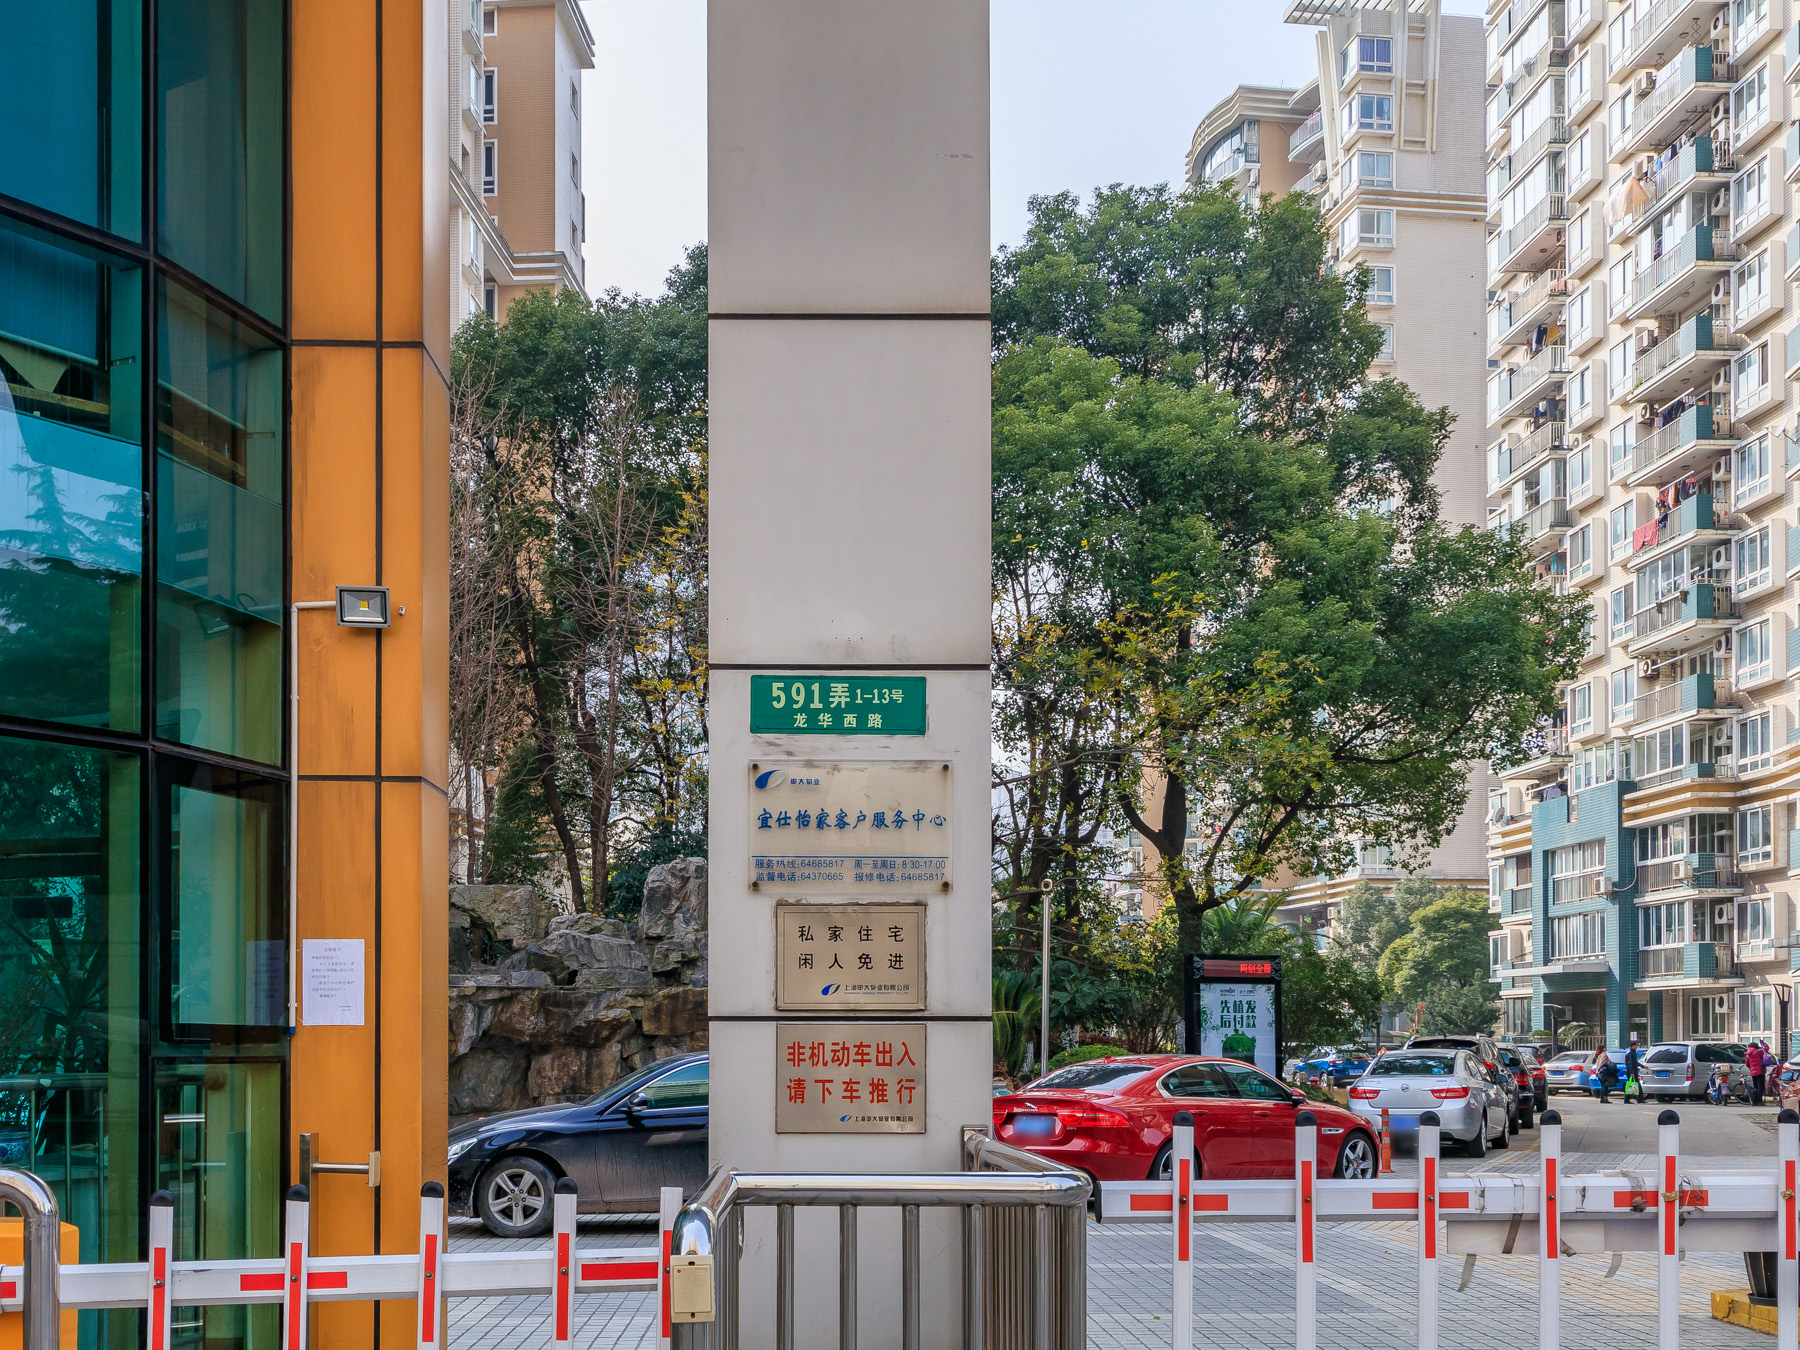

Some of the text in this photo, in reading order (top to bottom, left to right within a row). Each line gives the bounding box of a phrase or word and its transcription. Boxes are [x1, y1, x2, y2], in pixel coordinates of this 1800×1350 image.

[793, 713, 883, 728] 龙华西路
[757, 808, 947, 831] 宜仕怡家客户服务中心
[755, 859, 845, 869] 服务热线:64685817
[755, 871, 945, 882] 监督电话:64370665 报修电话:64685817
[798, 925, 904, 943] 私家住宅
[798, 953, 904, 970] 闲人免进
[1220, 1000, 1256, 1014] 先植发
[1220, 1014, 1256, 1028] 后付款
[786, 1041, 916, 1068] 非机动车出入
[786, 1077, 916, 1104] 请下车推行
